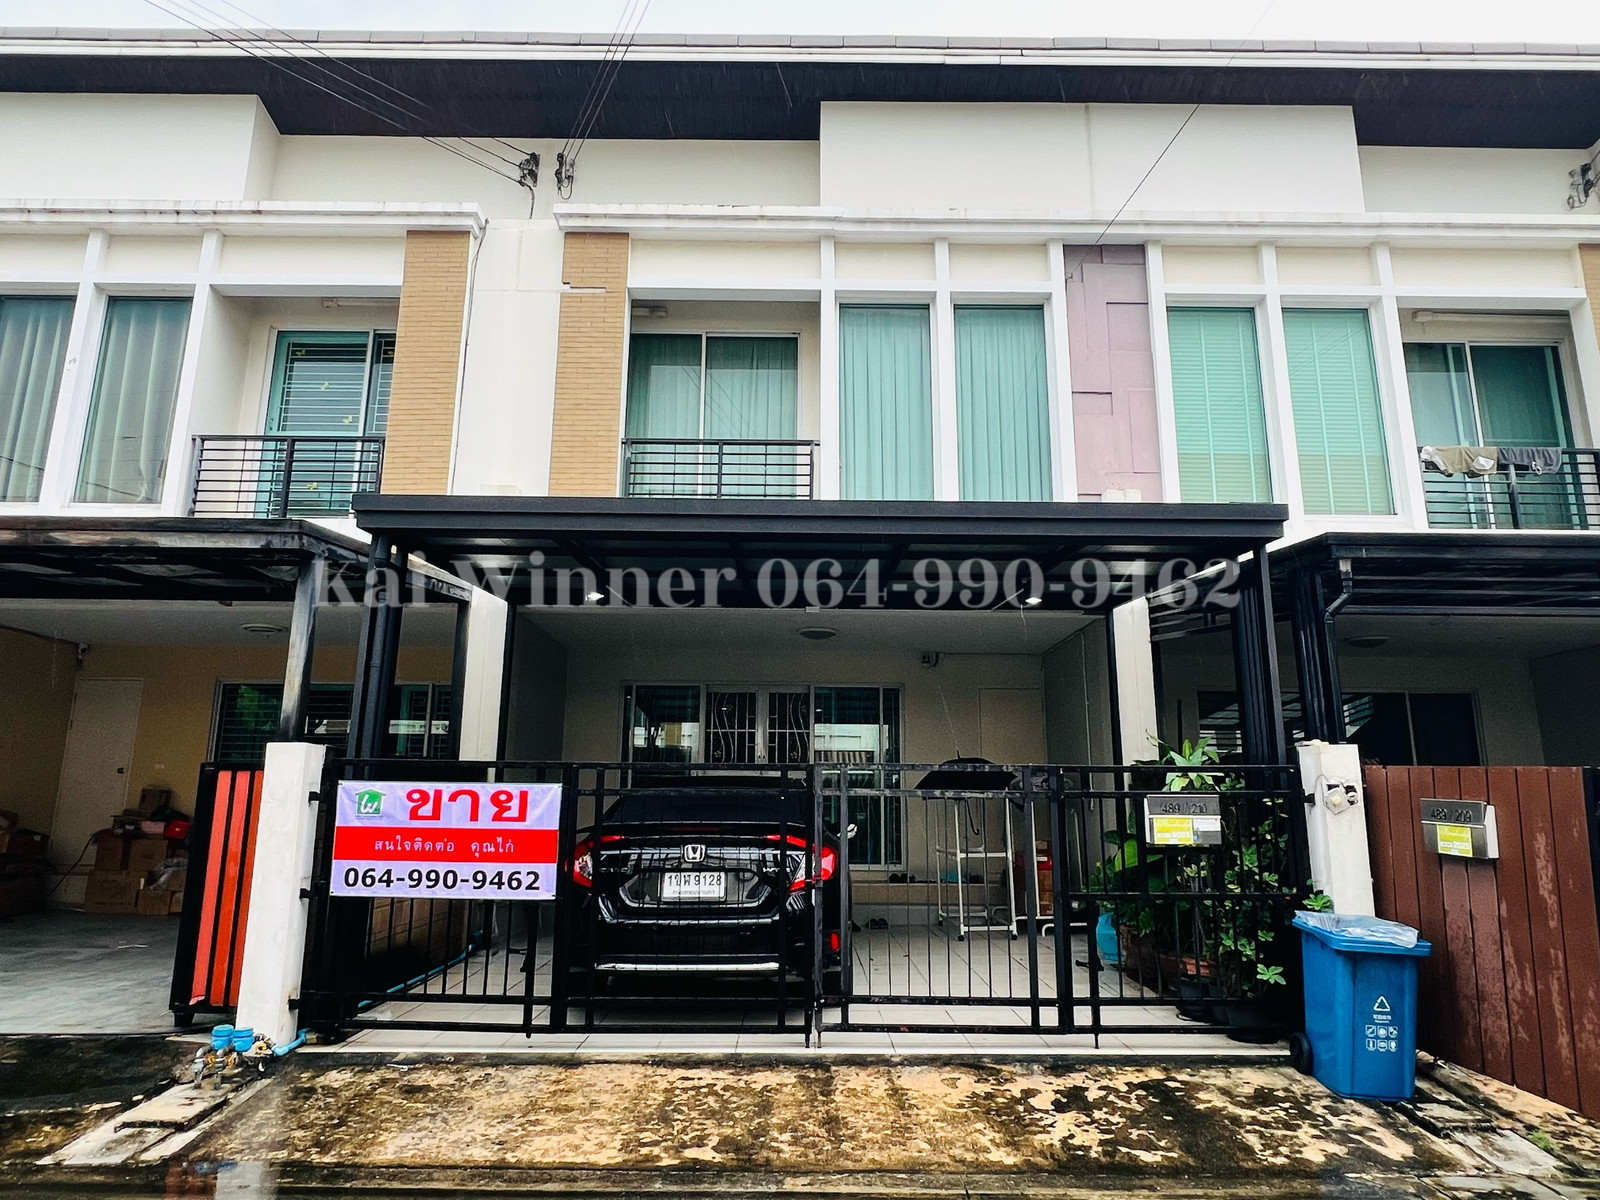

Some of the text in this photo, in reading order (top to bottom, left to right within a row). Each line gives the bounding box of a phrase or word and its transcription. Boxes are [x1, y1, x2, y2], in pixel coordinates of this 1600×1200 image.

[405, 788, 529, 823] ขาย
[374, 835, 514, 858] สนใจติดต่อ คุณไก่
[344, 867, 541, 891] 064-990-9462
[693, 874, 722, 887] 9128
